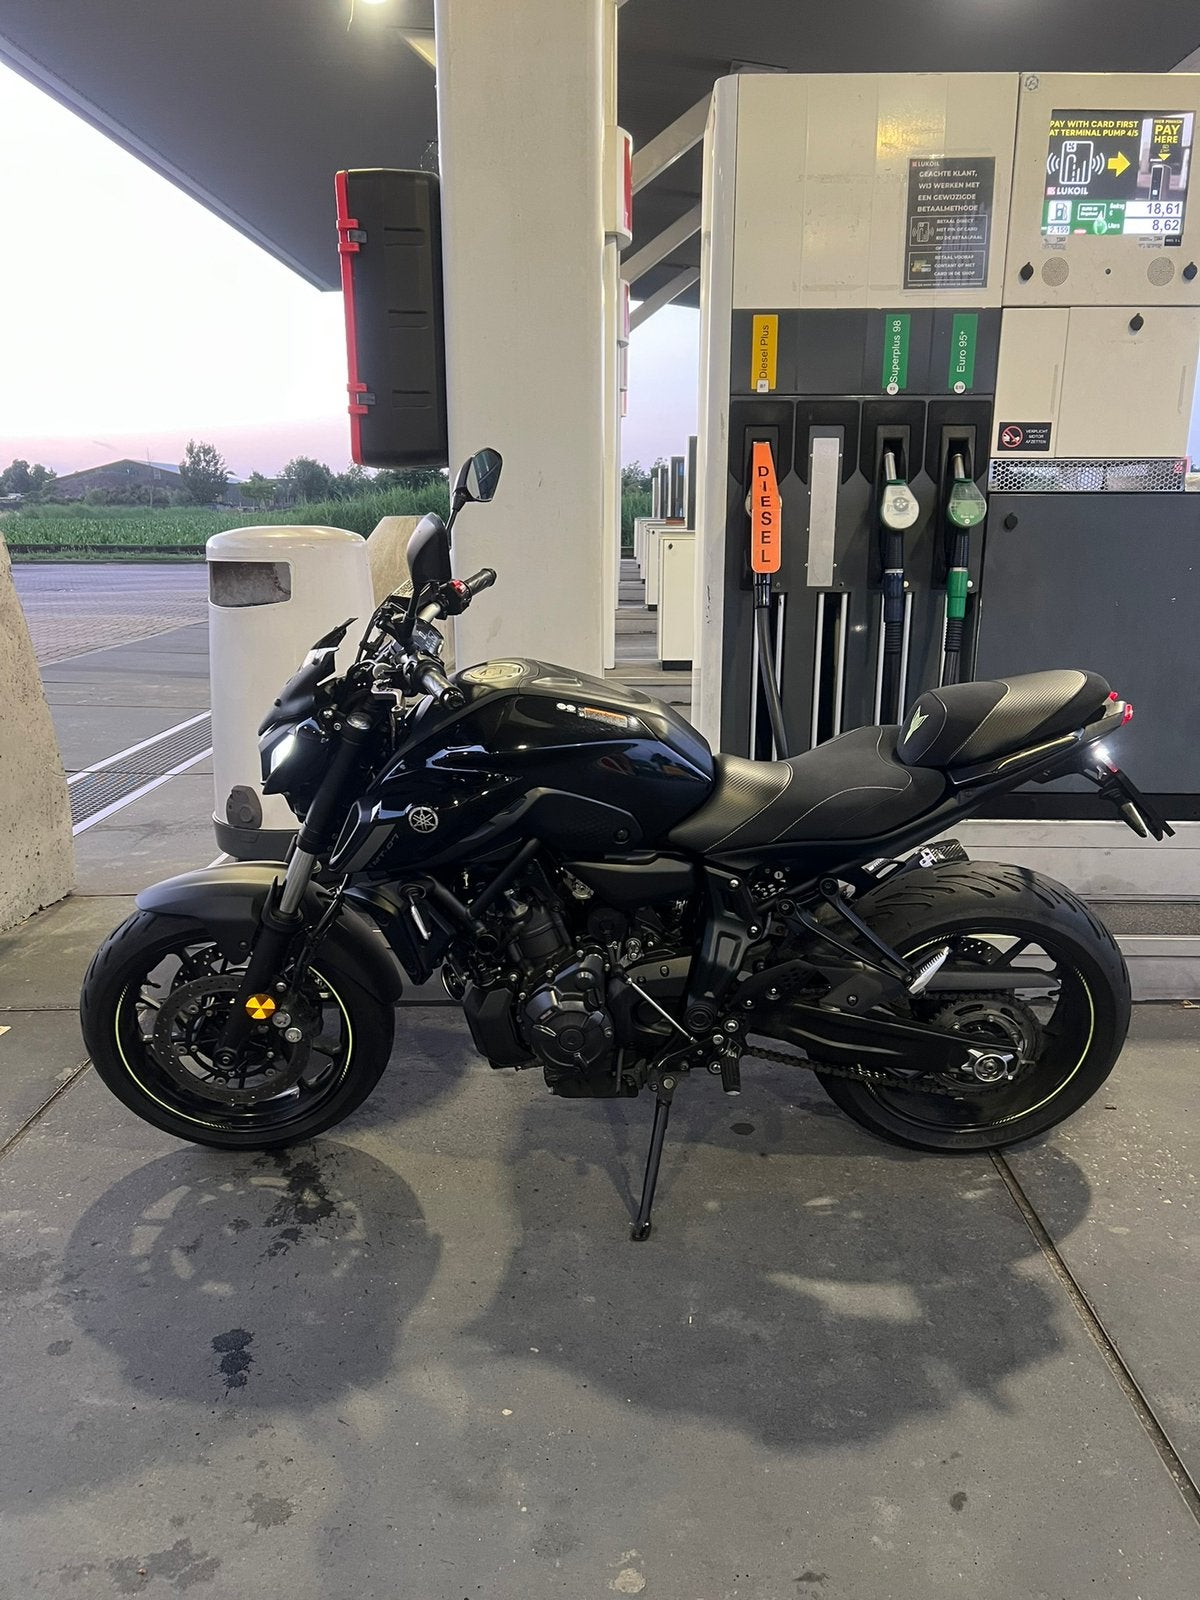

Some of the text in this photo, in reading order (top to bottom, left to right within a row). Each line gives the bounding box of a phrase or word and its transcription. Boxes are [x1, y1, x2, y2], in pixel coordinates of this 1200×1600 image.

[1050, 120, 1139, 129] PAY WITH CARD FIRST
[1049, 129, 1139, 137] AT TERMINAL PUMP 4/5
[1154, 124, 1180, 135] PAY
[1154, 135, 1178, 144] HERE
[919, 169, 978, 178] GEACHTE KLANT,
[933, 181, 964, 189] WERKEN
[965, 181, 980, 189] MET
[1056, 187, 1089, 195] LUKOIL
[933, 193, 976, 201] GEWIJZIGDE
[917, 204, 978, 212] BETAALMETHODE
[1147, 203, 1180, 217] 18,61
[1152, 219, 1179, 232] 8,62
[758, 324, 770, 379] Diesel Plus
[889, 319, 902, 383] Superplus 98
[956, 330, 968, 373] Euro 95+
[758, 465, 772, 563] DIESEL
